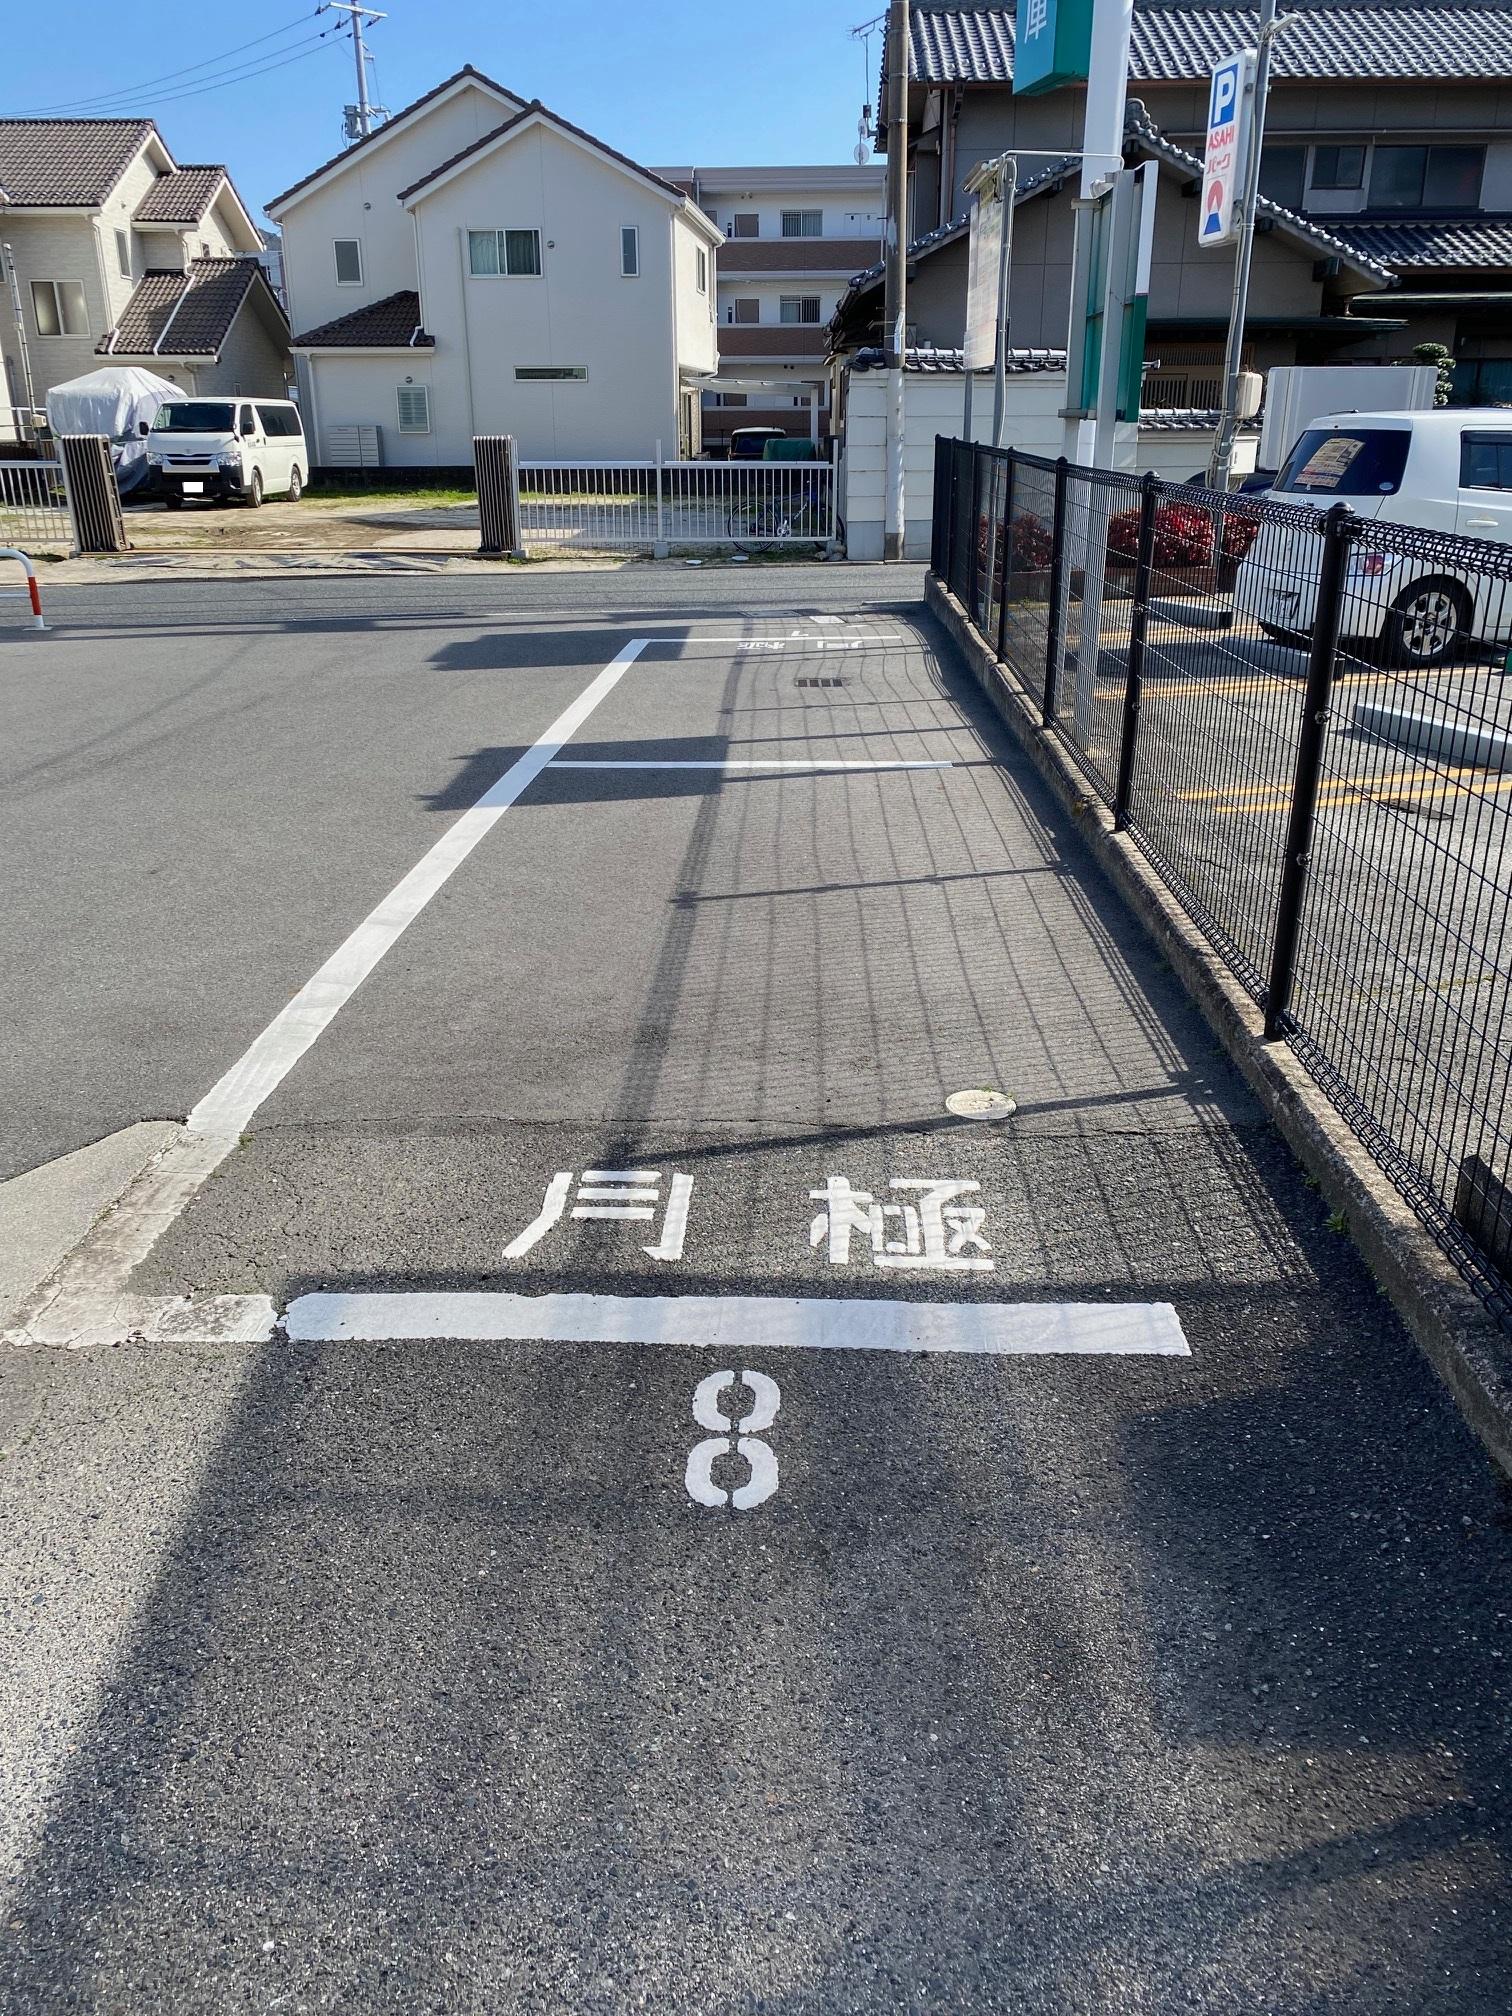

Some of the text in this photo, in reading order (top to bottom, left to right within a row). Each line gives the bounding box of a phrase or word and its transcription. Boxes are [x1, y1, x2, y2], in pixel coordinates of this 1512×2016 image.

[1213, 70, 1236, 123] P
[1207, 153, 1230, 174] パーク
[1208, 125, 1234, 152] ASAHI
[502, 1170, 994, 1271] 月極
[684, 1369, 781, 1511] 8
